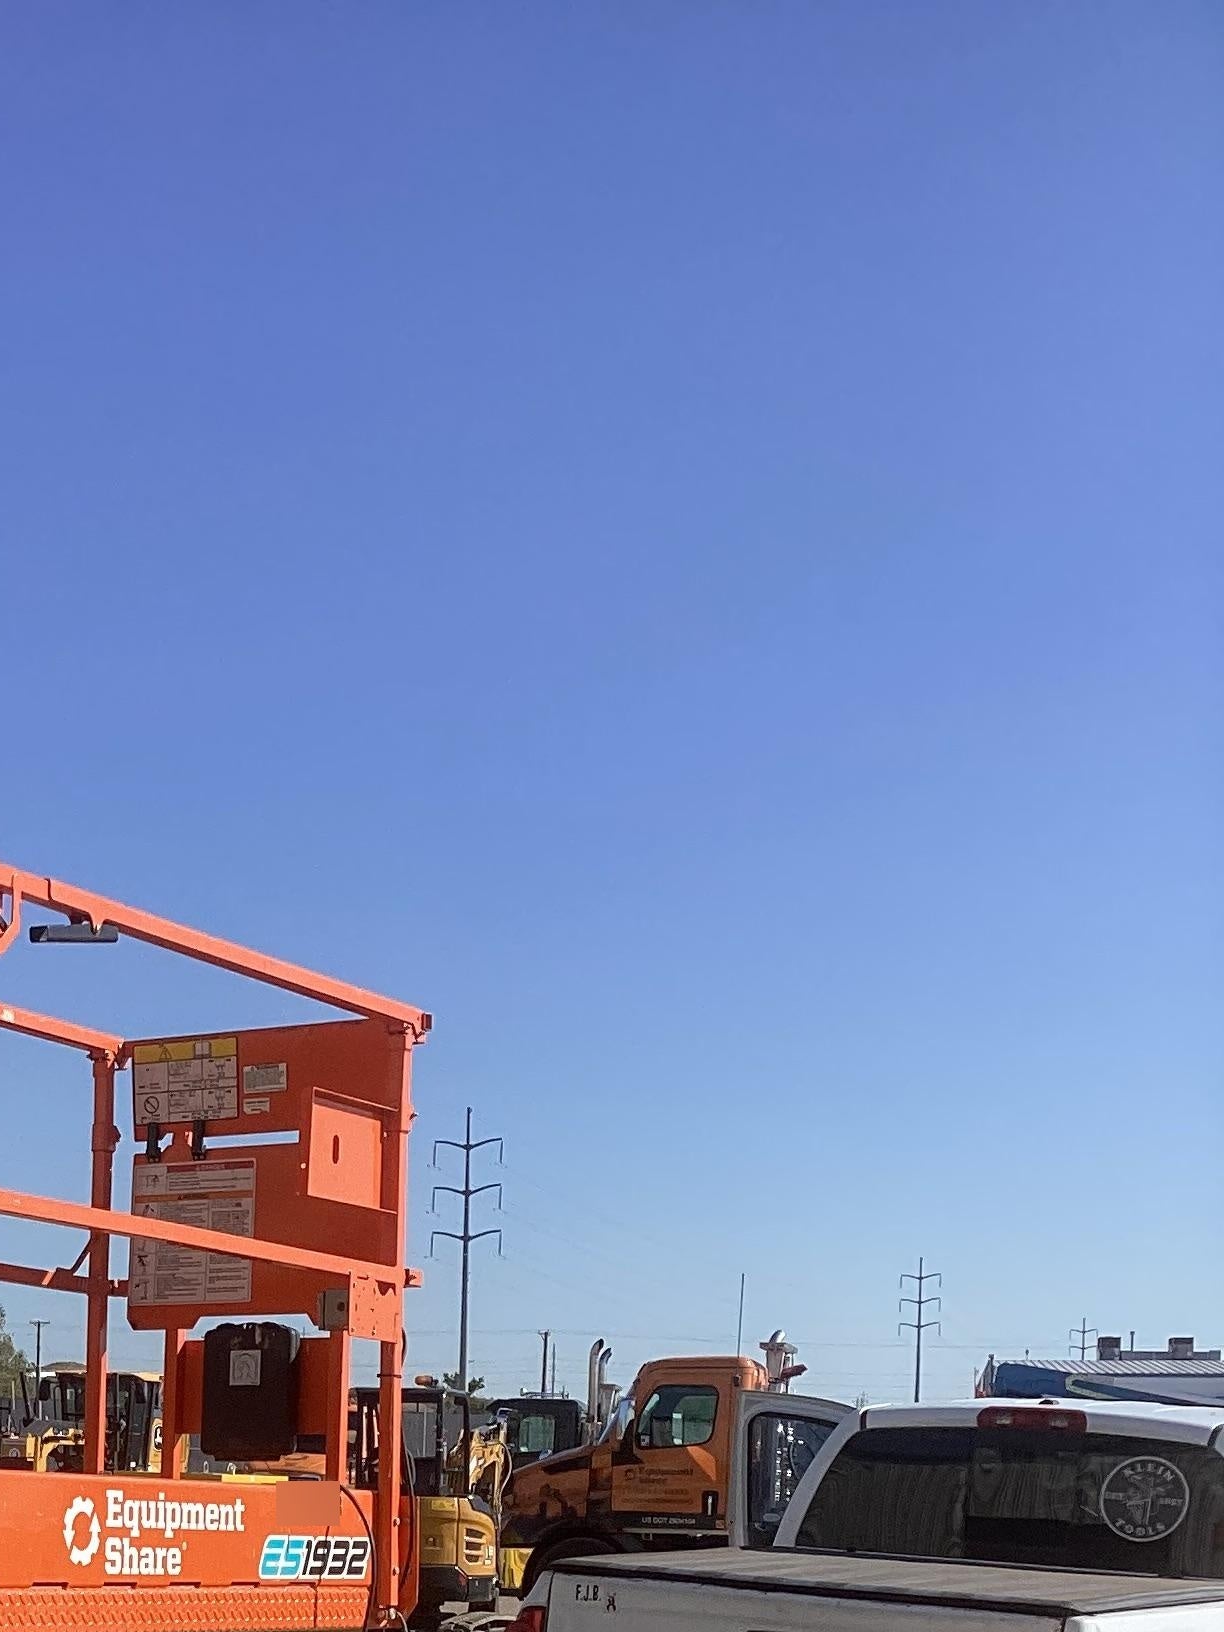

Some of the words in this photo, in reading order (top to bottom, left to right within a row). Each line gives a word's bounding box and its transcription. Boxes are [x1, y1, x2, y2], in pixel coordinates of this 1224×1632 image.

[105, 1488, 246, 1539] Equipment
[104, 1536, 182, 1576] Share
[260, 1536, 370, 1578] ES1932
